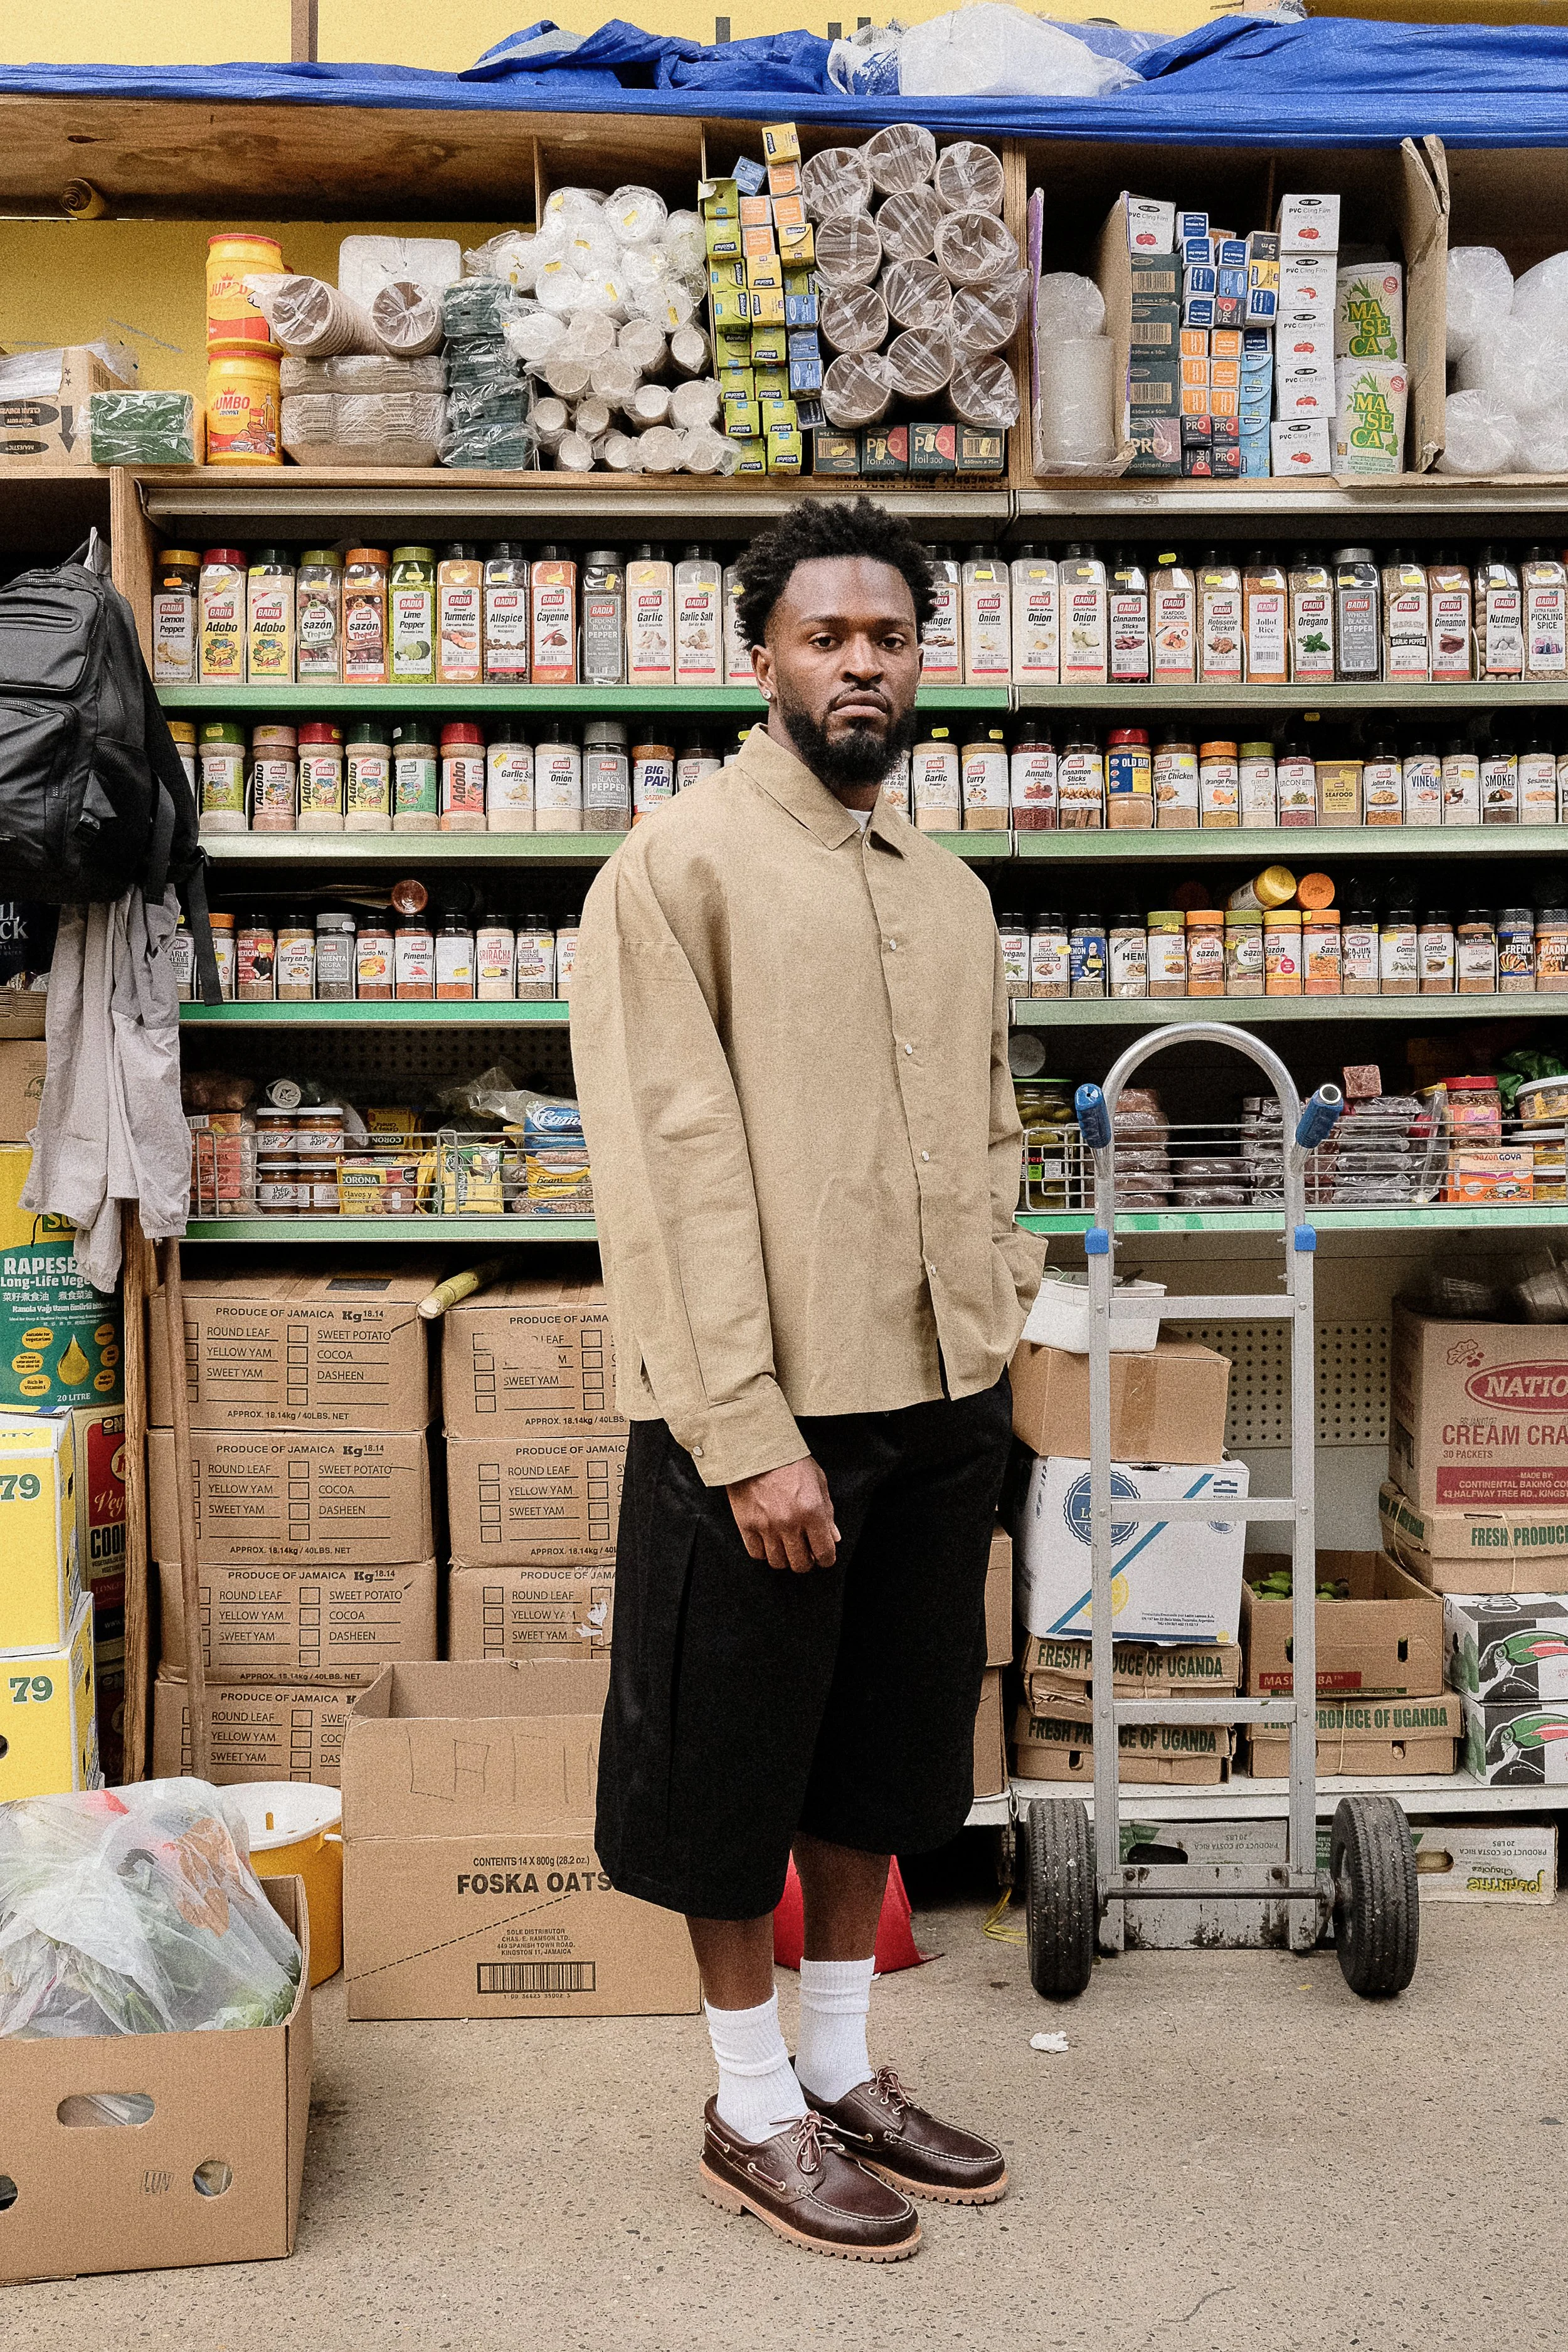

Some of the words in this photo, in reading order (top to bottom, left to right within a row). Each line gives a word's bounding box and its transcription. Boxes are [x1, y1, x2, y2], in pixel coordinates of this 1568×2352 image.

[211, 396, 250, 410] JUMBO
[1356, 395, 1387, 412] MA
[1186, 421, 1206, 430] PRO
[1367, 413, 1392, 430] SE
[1353, 430, 1381, 447] CA
[914, 454, 928, 464] foil
[1216, 453, 1234, 462] PRO
[450, 596, 470, 605] BADIA
[495, 597, 516, 606] BADIA
[542, 595, 563, 605] BADIA
[640, 596, 660, 605] BADIA
[1074, 596, 1095, 605] BADIA
[1496, 599, 1515, 607] BADIA
[161, 605, 183, 613] BADIA
[258, 608, 280, 617] BADIA
[592, 606, 613, 615] BADIA
[161, 615, 184, 623] Lemon
[403, 611, 421, 619] Lime
[445, 612, 475, 621] Turmeric
[490, 613, 522, 623] Allspice
[537, 613, 569, 622] Cayenne
[637, 613, 663, 622] Garlic
[680, 612, 701, 622] Garlic
[702, 612, 714, 621] Salt
[979, 614, 1000, 622] Onion
[1028, 613, 1052, 623] Onion
[1073, 613, 1097, 622] Onion
[1490, 614, 1519, 625] Nutmeg
[1531, 613, 1563, 621] PICKLING
[205, 622, 238, 632] Adobo
[253, 622, 285, 632] Adobo
[304, 620, 332, 629] sazón
[350, 622, 378, 631] sazón
[400, 621, 425, 630] Pepper
[1298, 617, 1328, 627] Oregano
[1435, 618, 1466, 627] Cinnamon
[160, 625, 186, 634] Pepper
[1344, 625, 1373, 633] PEPPER
[1392, 637, 1406, 646] GARLIC
[1407, 637, 1426, 645] PEPPER
[1122, 758, 1136, 767] OLD
[1137, 758, 1148, 768] BAY
[645, 765, 664, 775] BIG
[1025, 770, 1053, 778] Annatto
[453, 762, 466, 803] Adobo
[551, 773, 572, 783] Onion
[924, 773, 947, 782] Garlic
[967, 775, 985, 784] Curry
[1485, 775, 1515, 787] SMOKED
[255, 764, 264, 806] Adobo
[303, 762, 312, 805] Adobo
[591, 783, 625, 792] PEPPER
[1424, 944, 1446, 952] Canela
[479, 950, 511, 960] SRIRACHA
[4, 1258, 78, 1274] RAPESE
[1, 1275, 59, 1290] Long-Life
[216, 1308, 268, 1316] PRODUCE
[270, 1309, 284, 1317] OF
[287, 1310, 334, 1318] JAMAICA
[342, 1311, 362, 1323] Kg
[208, 1327, 243, 1337] ROUND
[246, 1328, 270, 1337] LEAF
[317, 1330, 351, 1339] SWEET
[353, 1331, 391, 1340] POTATO
[207, 1347, 246, 1357] YELLOW
[249, 1348, 272, 1357] YAM
[317, 1350, 353, 1360] COCOA
[208, 1368, 239, 1377] SWEET
[241, 1369, 263, 1377] YAM
[317, 1371, 364, 1380] DASHEEN
[1485, 1376, 1568, 1397] NATIO
[68, 1393, 91, 1401] LITRE
[266, 1411, 295, 1420] 18.14kg
[1443, 1424, 1520, 1445] CREAM
[1443, 1450, 1454, 1458] 30
[1456, 1450, 1493, 1459] PACKETS
[0, 1473, 41, 1500] 79
[1471, 1527, 1508, 1547] FRESH
[1147, 1656, 1164, 1677] OF
[1167, 1656, 1222, 1678] UGANDA
[10, 1676, 53, 1703] 79
[1374, 1708, 1391, 1728] OF
[1393, 1707, 1448, 1728] UGANDA
[474, 1857, 517, 1867] CONTENTS
[519, 1857, 527, 1865] 14
[529, 1857, 534, 1865] X
[536, 1857, 554, 1867] 800g
[556, 1856, 575, 1867] (28.2
[576, 1856, 590, 1865] oz.)
[457, 1873, 539, 1895] FOSKA
[546, 1872, 612, 1892] OATS
